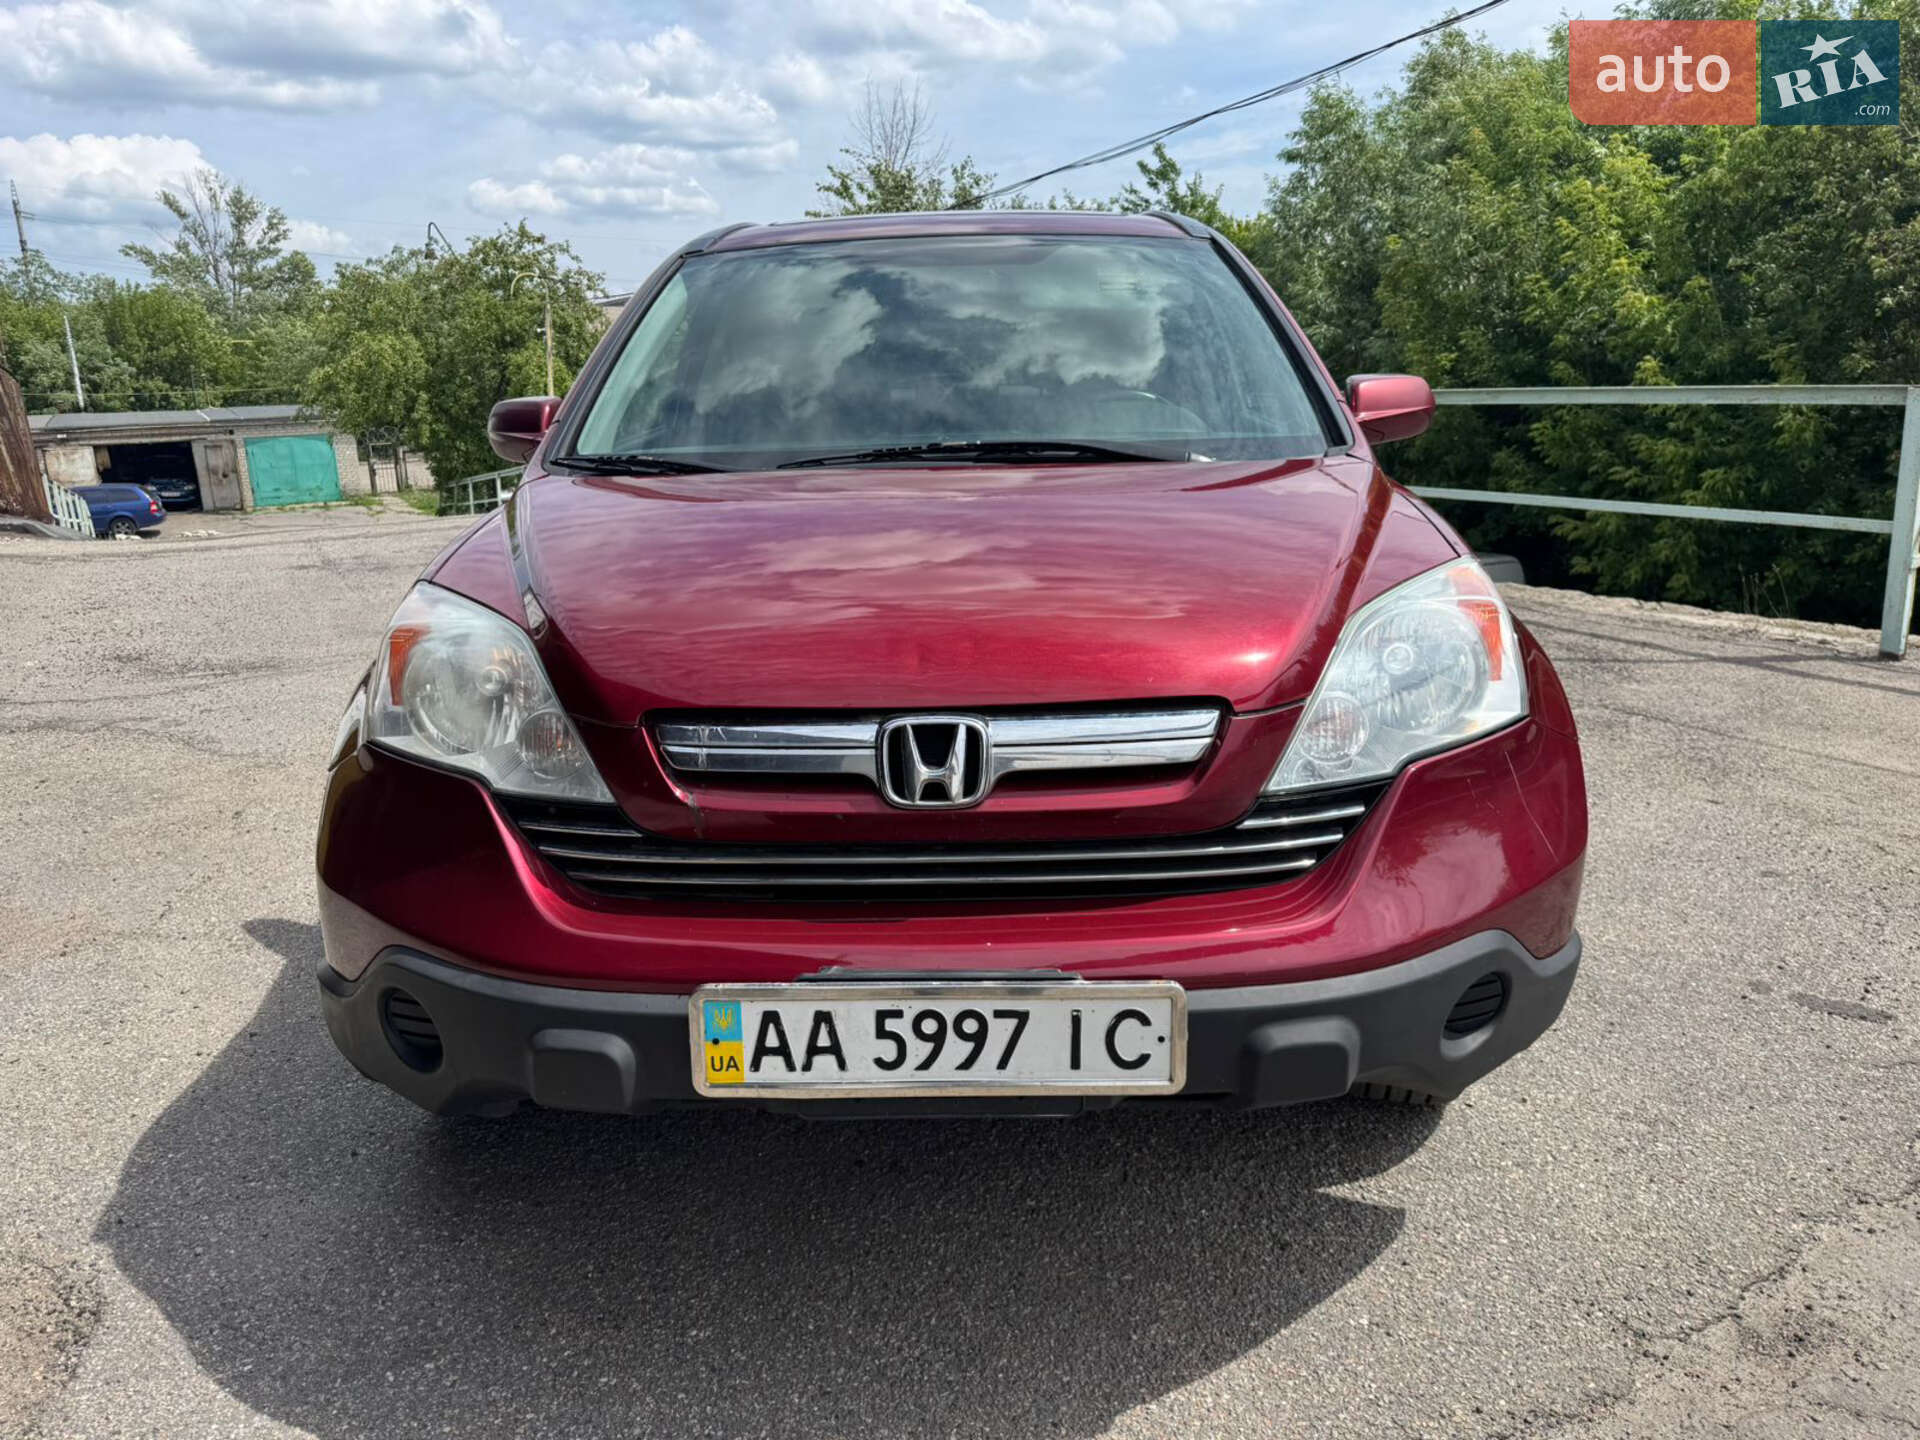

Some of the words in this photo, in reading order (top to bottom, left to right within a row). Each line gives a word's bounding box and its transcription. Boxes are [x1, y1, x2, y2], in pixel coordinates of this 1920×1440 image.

[749, 1010, 848, 1073] AA
[873, 1009, 1030, 1071] 5997
[1070, 1009, 1153, 1070] IC
[710, 1057, 740, 1073] UA
